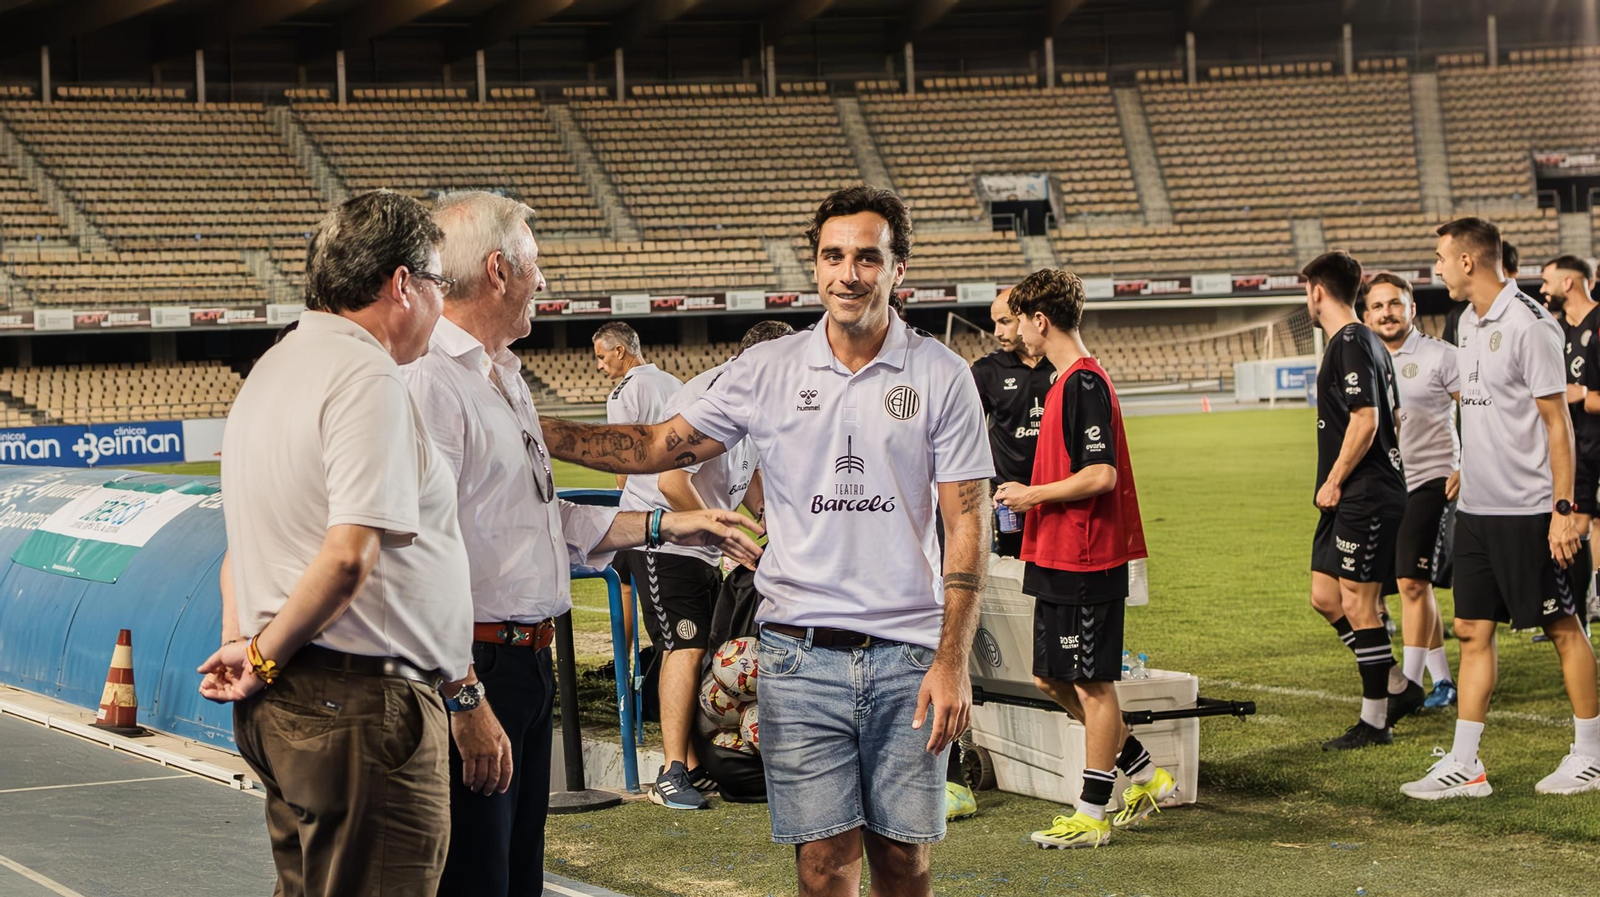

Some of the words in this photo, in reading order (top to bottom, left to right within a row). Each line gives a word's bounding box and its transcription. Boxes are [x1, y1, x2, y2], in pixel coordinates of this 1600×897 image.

[0, 432, 26, 441] nicas
[0, 438, 61, 460] man
[835, 484, 864, 495] TEATRO
[811, 494, 895, 514] Barceló
